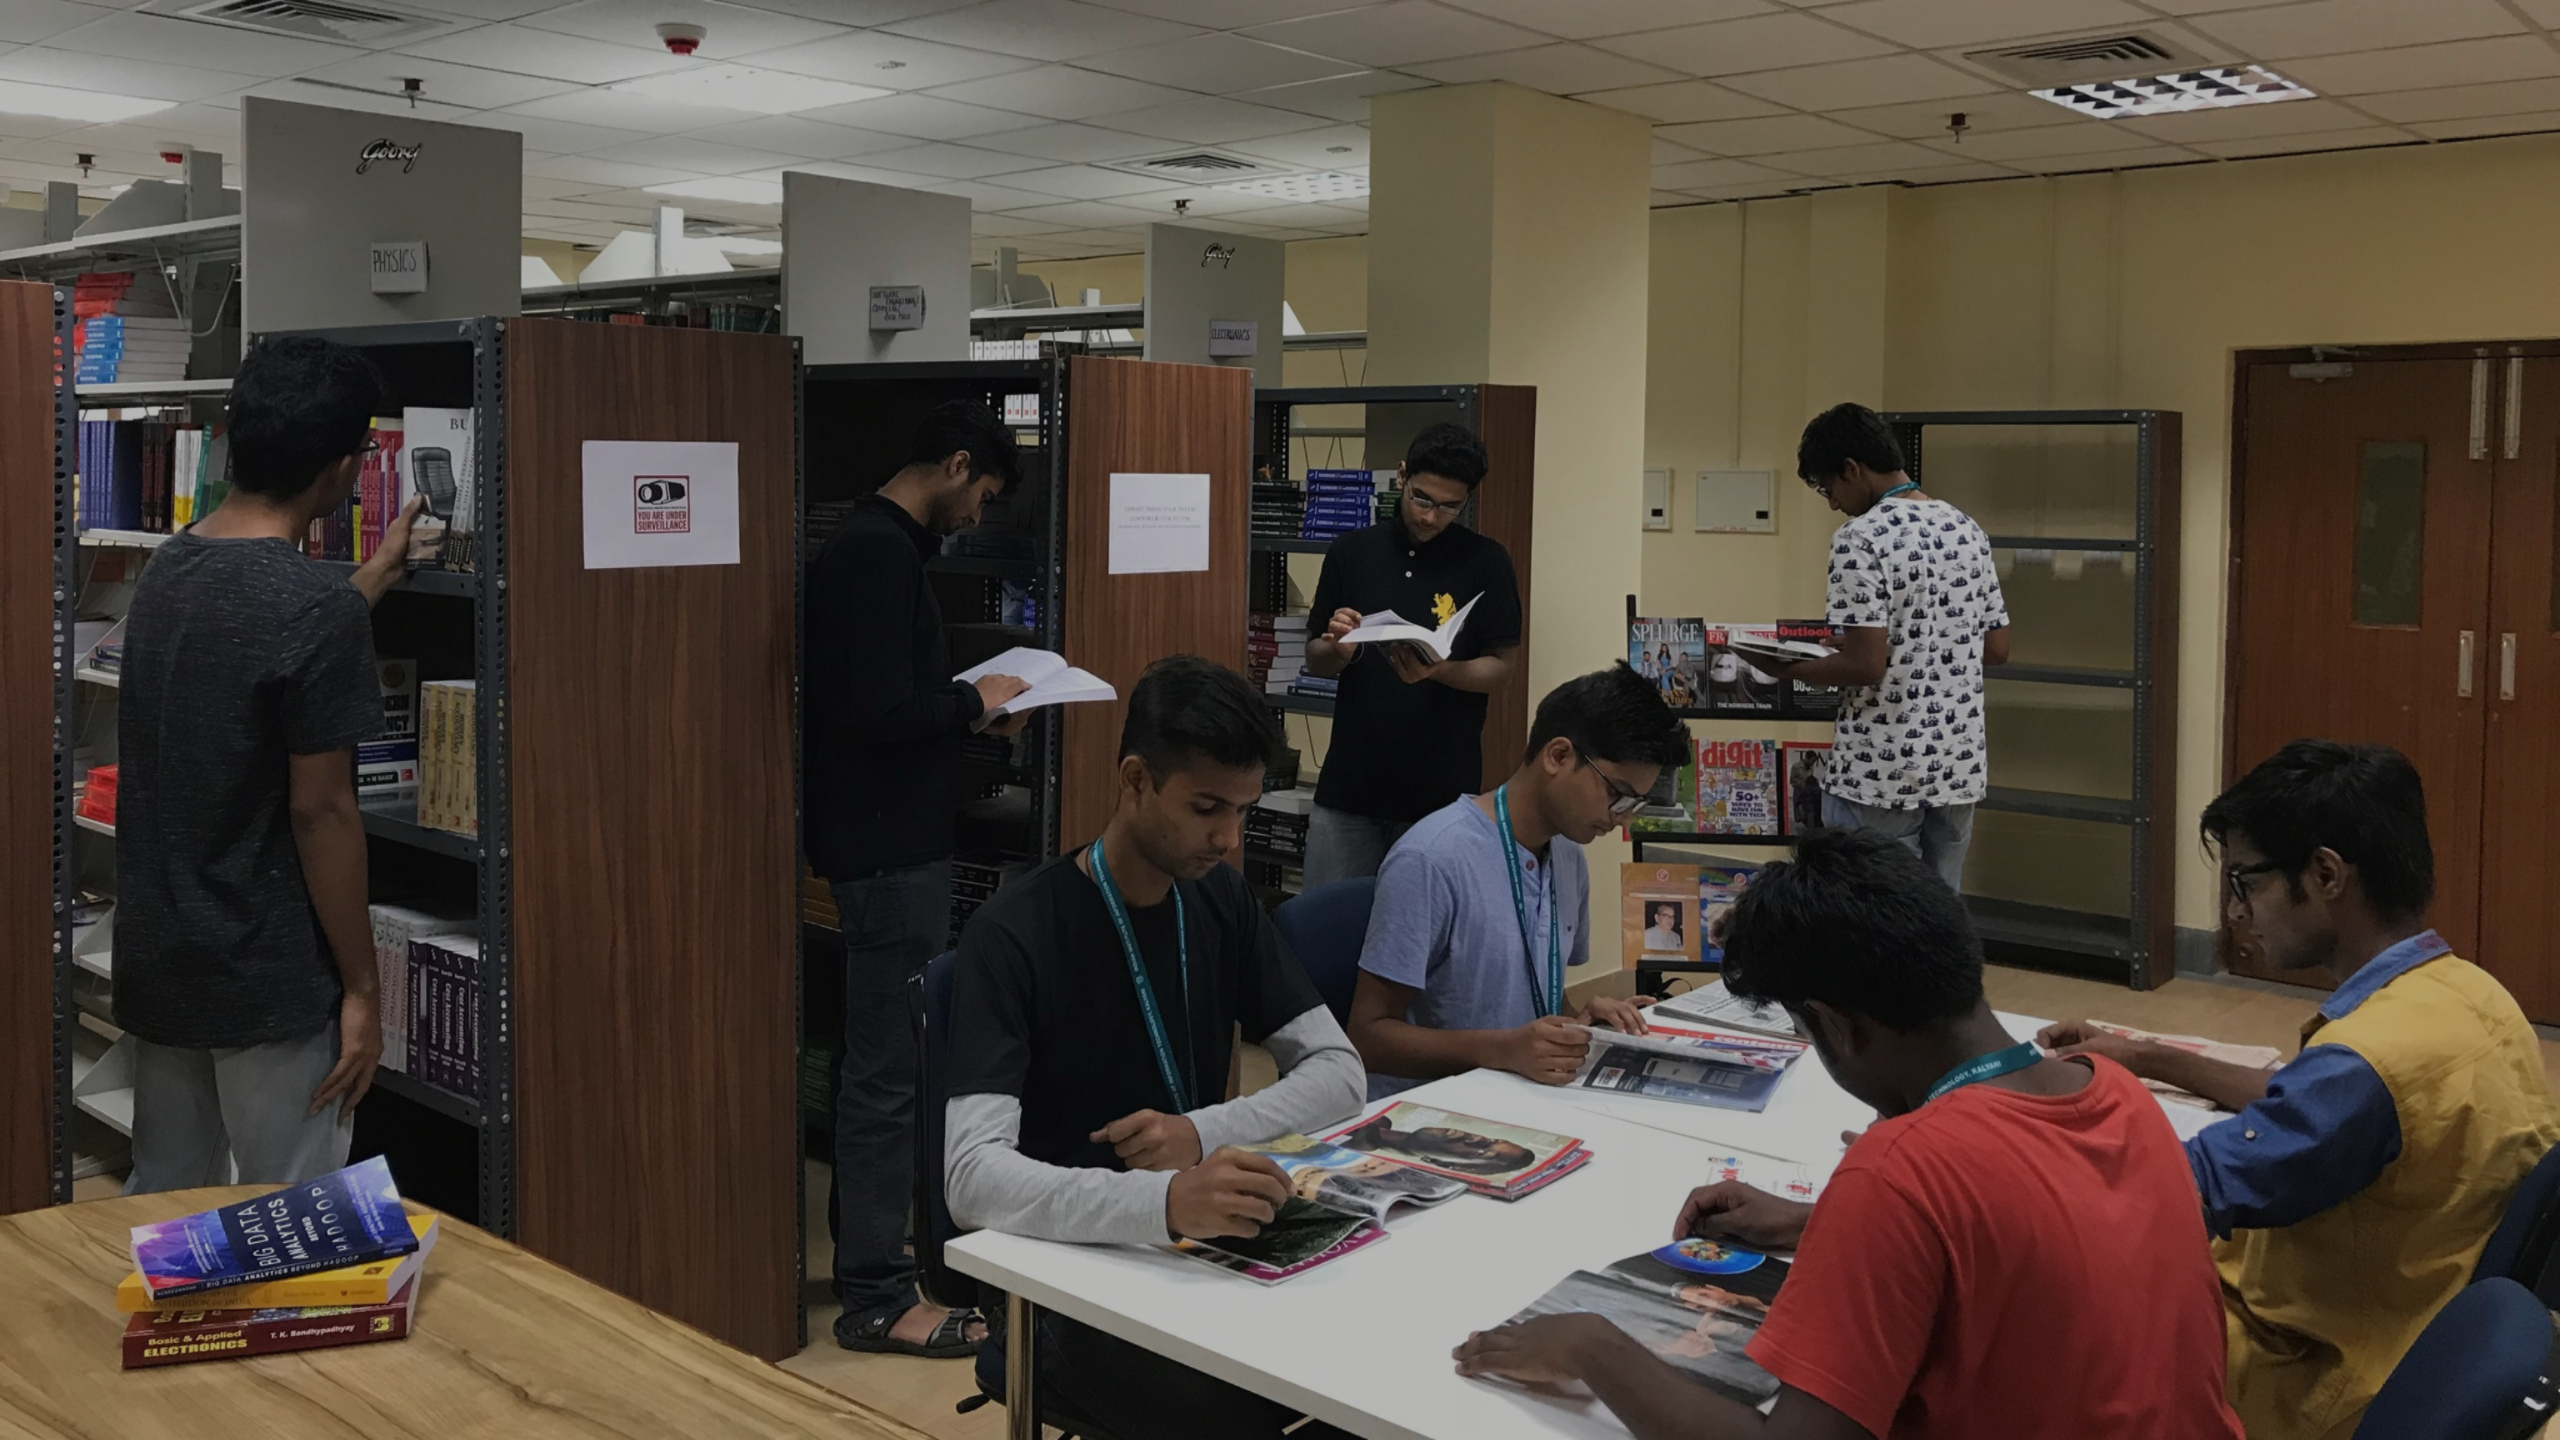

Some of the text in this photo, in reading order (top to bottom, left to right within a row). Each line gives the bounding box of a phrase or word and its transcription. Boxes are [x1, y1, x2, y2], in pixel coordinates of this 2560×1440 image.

[356, 138, 422, 174] Godrej
[373, 249, 417, 273] PHYSICS
[1211, 328, 1251, 341] ELECTRONICS
[638, 511, 686, 520] YOU ARE UNDER
[638, 520, 687, 531] SURVEILLANCE
[1632, 622, 1700, 643] SPLURGE
[1779, 626, 1833, 637] Outlook
[1701, 741, 1765, 768] digit
[1735, 791, 1760, 801] 50+
[1101, 880, 1121, 917] INFORMATION
[1119, 924, 1134, 952] INSTITUTE
[388, 951, 399, 1027] ACCOUNTING
[1139, 987, 1151, 1011] KALYANI
[443, 983, 452, 1051] Cost Accounting
[457, 986, 466, 1056] Cost Accounting
[1158, 1047, 1174, 1084] INFORMATION
[1923, 1057, 2001, 1101] TECHNOLOGY, KALYANI
[267, 1197, 309, 1260] ANALYTICS
[302, 1216, 320, 1242] BEYOND
[311, 1187, 353, 1252] HADOOP
[237, 1204, 281, 1267] BIG DATA
[222, 1276, 242, 1286] DATA
[244, 1268, 289, 1281] ANALYTICS
[291, 1261, 321, 1273] BEYOND
[323, 1254, 360, 1266] HADOOP
[225, 1297, 251, 1306] INDIA
[143, 1338, 247, 1358] ELECTRONICS
[148, 1337, 179, 1346] Basic
[196, 1330, 242, 1342] Applied
